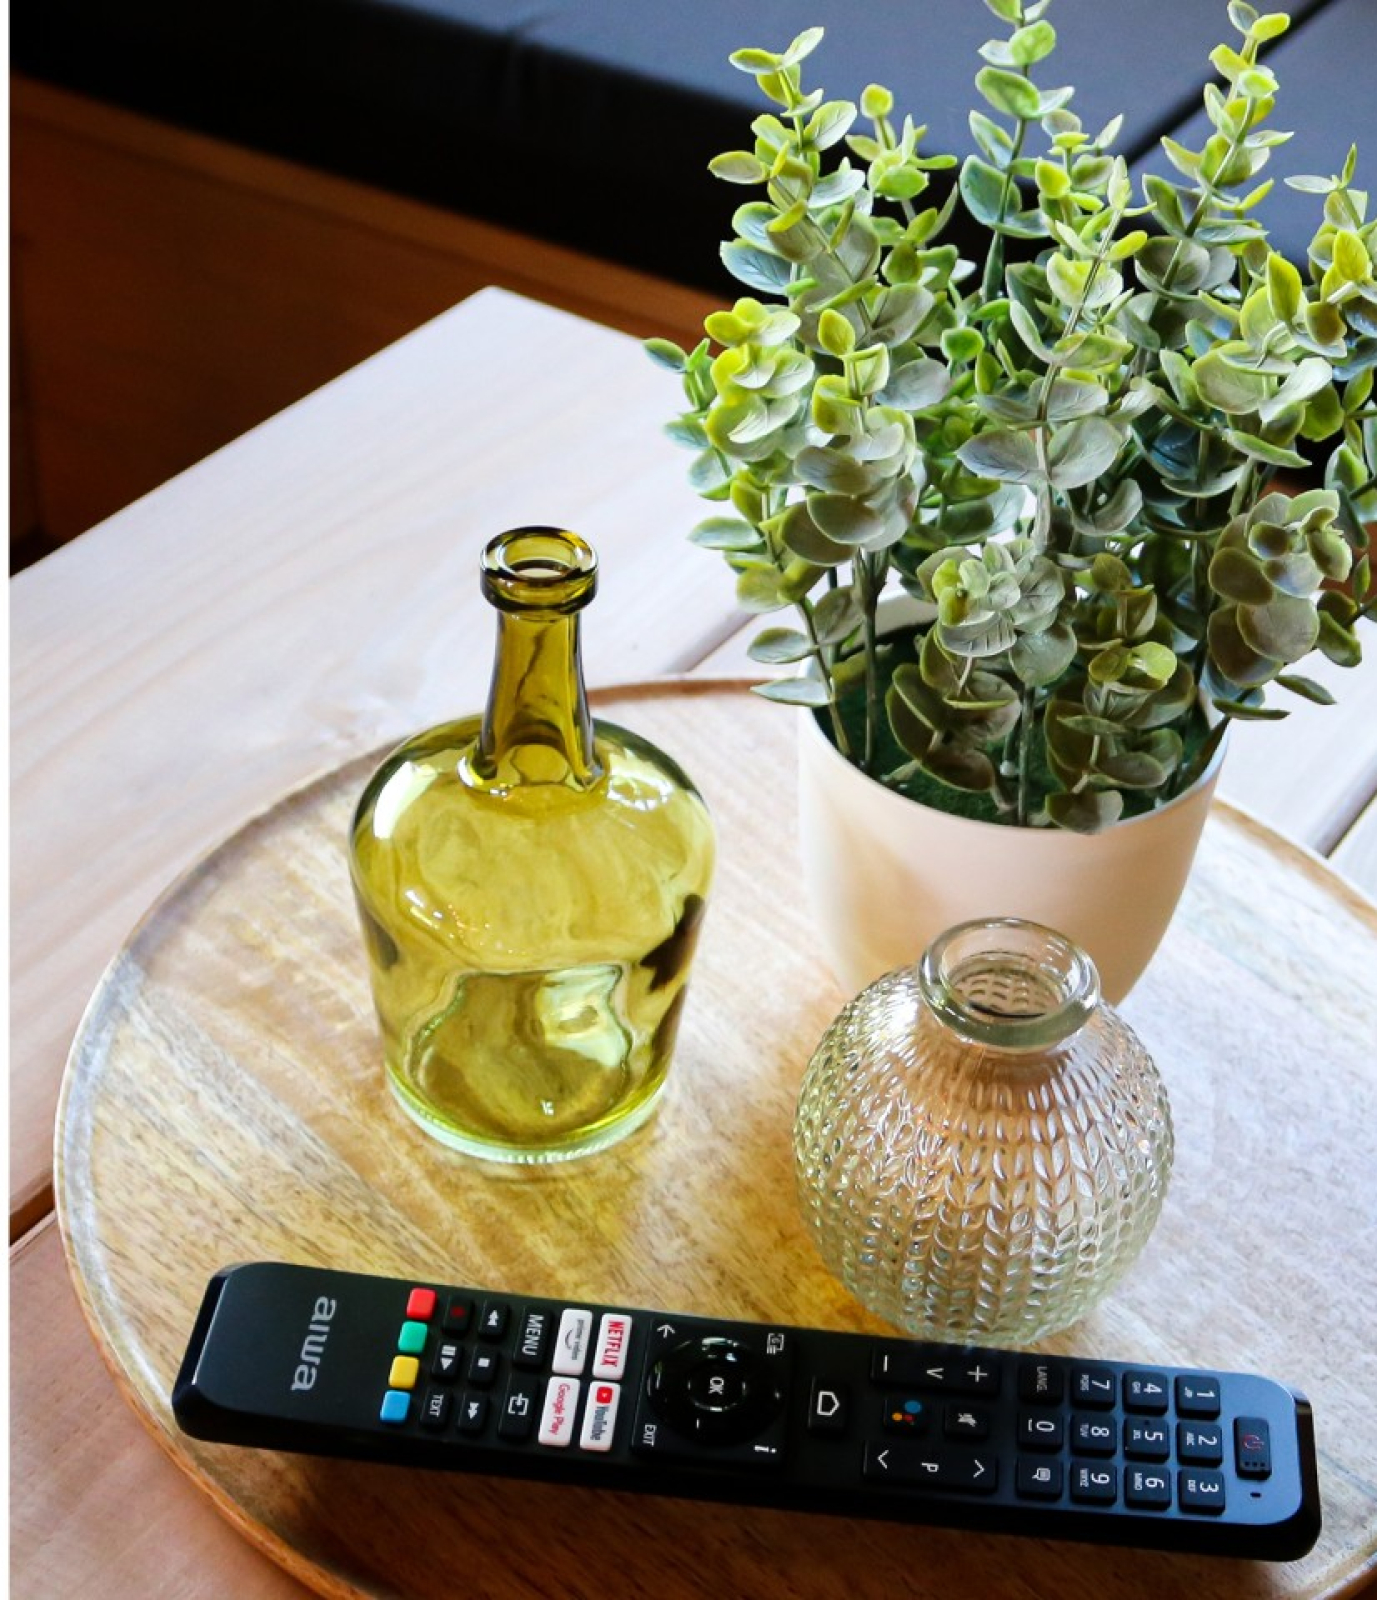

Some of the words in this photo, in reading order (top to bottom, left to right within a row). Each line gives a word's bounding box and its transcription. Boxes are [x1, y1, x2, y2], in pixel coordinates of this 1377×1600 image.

[522, 1314, 544, 1355] MENU
[600, 1320, 625, 1367] NETFLIX
[926, 1367, 944, 1380] V
[708, 1376, 724, 1395] OK
[1091, 1379, 1110, 1390] 7
[1143, 1383, 1162, 1394] 4
[551, 1383, 570, 1415] Google
[1196, 1390, 1215, 1398] 1
[429, 1394, 444, 1417] TEXT
[548, 1416, 565, 1436] Play
[590, 1405, 609, 1441] YouTube
[1036, 1420, 1055, 1432] 0
[642, 1424, 657, 1446] EXIT
[1091, 1426, 1110, 1437] 8
[1144, 1430, 1164, 1441] 5
[1198, 1434, 1217, 1446] 2
[921, 1462, 939, 1473] P
[1091, 1473, 1110, 1484] 9
[1145, 1477, 1164, 1489] 6
[1199, 1481, 1219, 1493] 3
